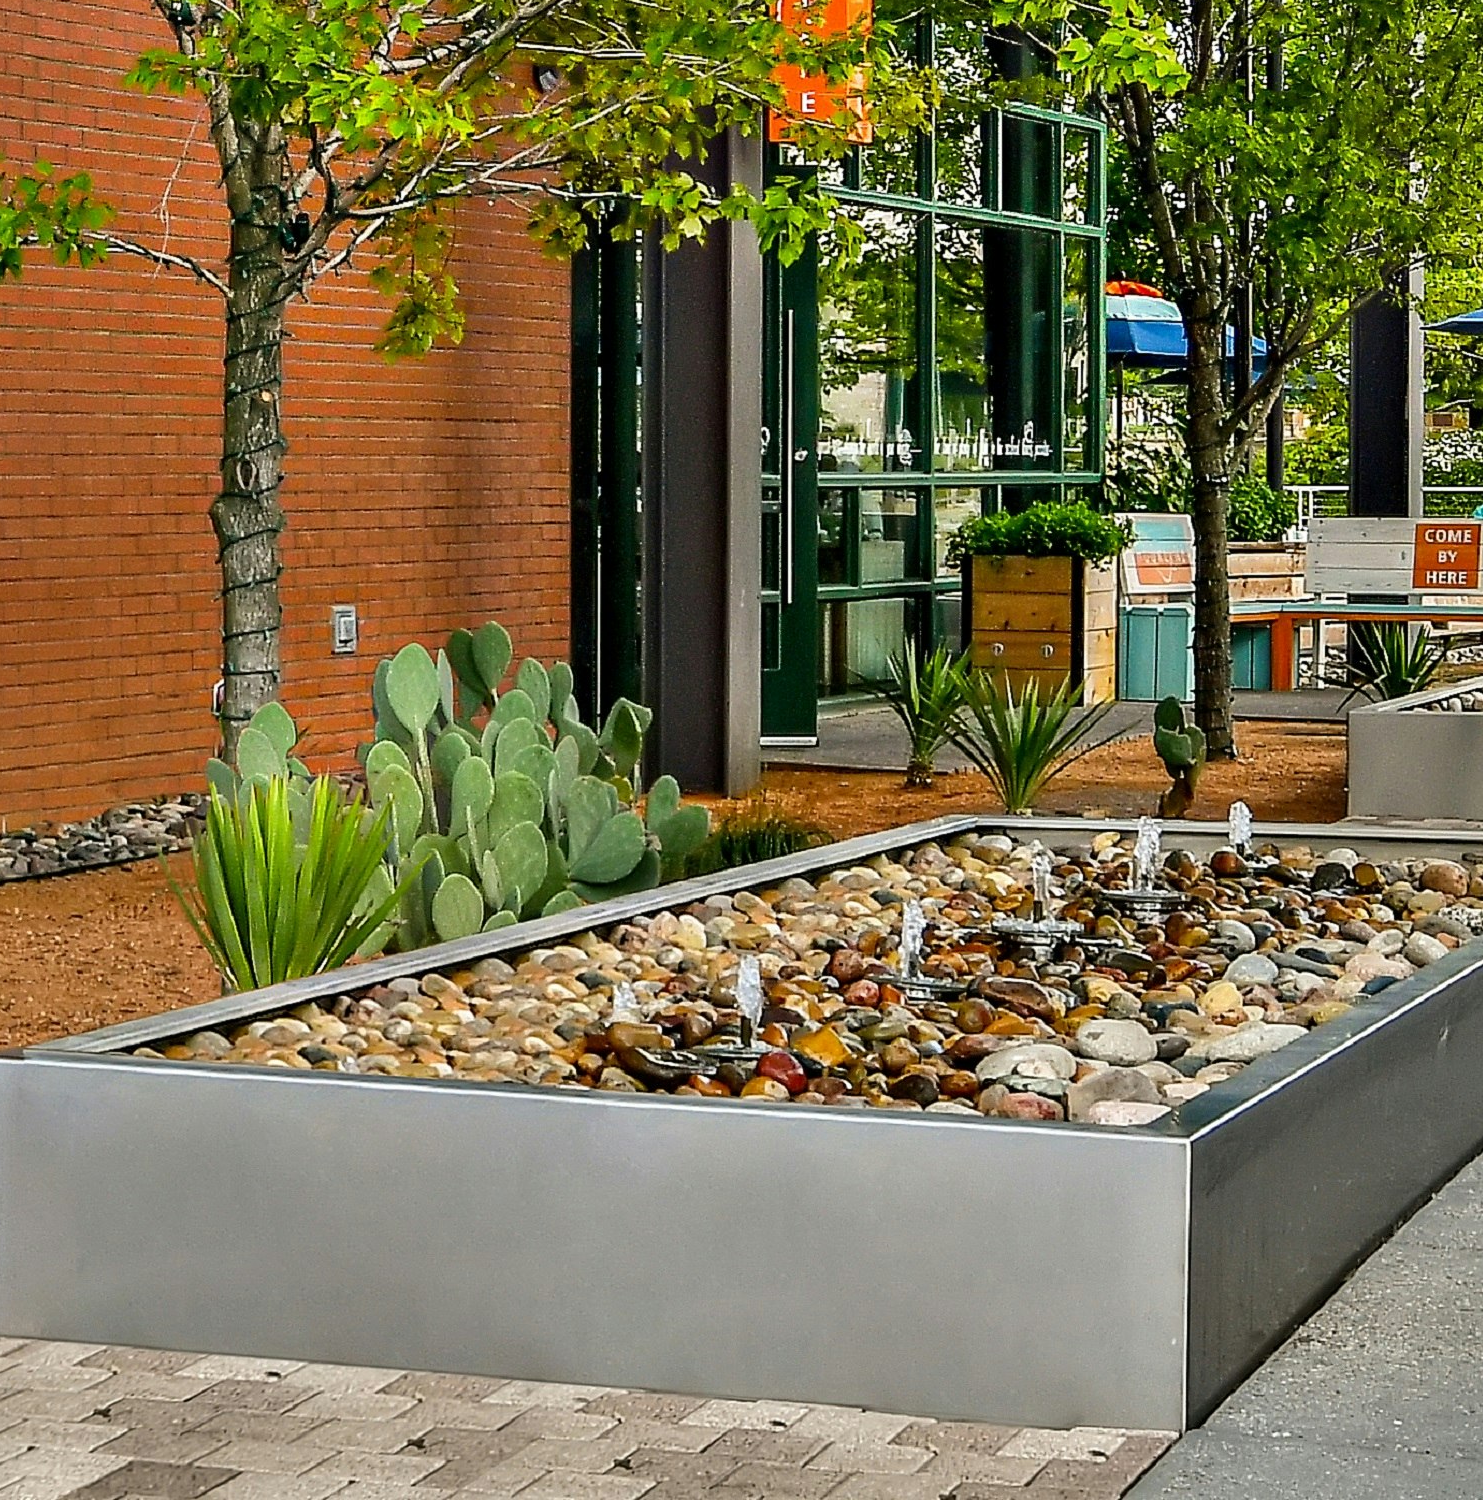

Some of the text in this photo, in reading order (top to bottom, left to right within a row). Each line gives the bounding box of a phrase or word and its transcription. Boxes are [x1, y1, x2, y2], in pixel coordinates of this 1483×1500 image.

[1424, 529, 1472, 543] COME
[1438, 550, 1458, 563] BY
[1426, 571, 1468, 585] HERE
